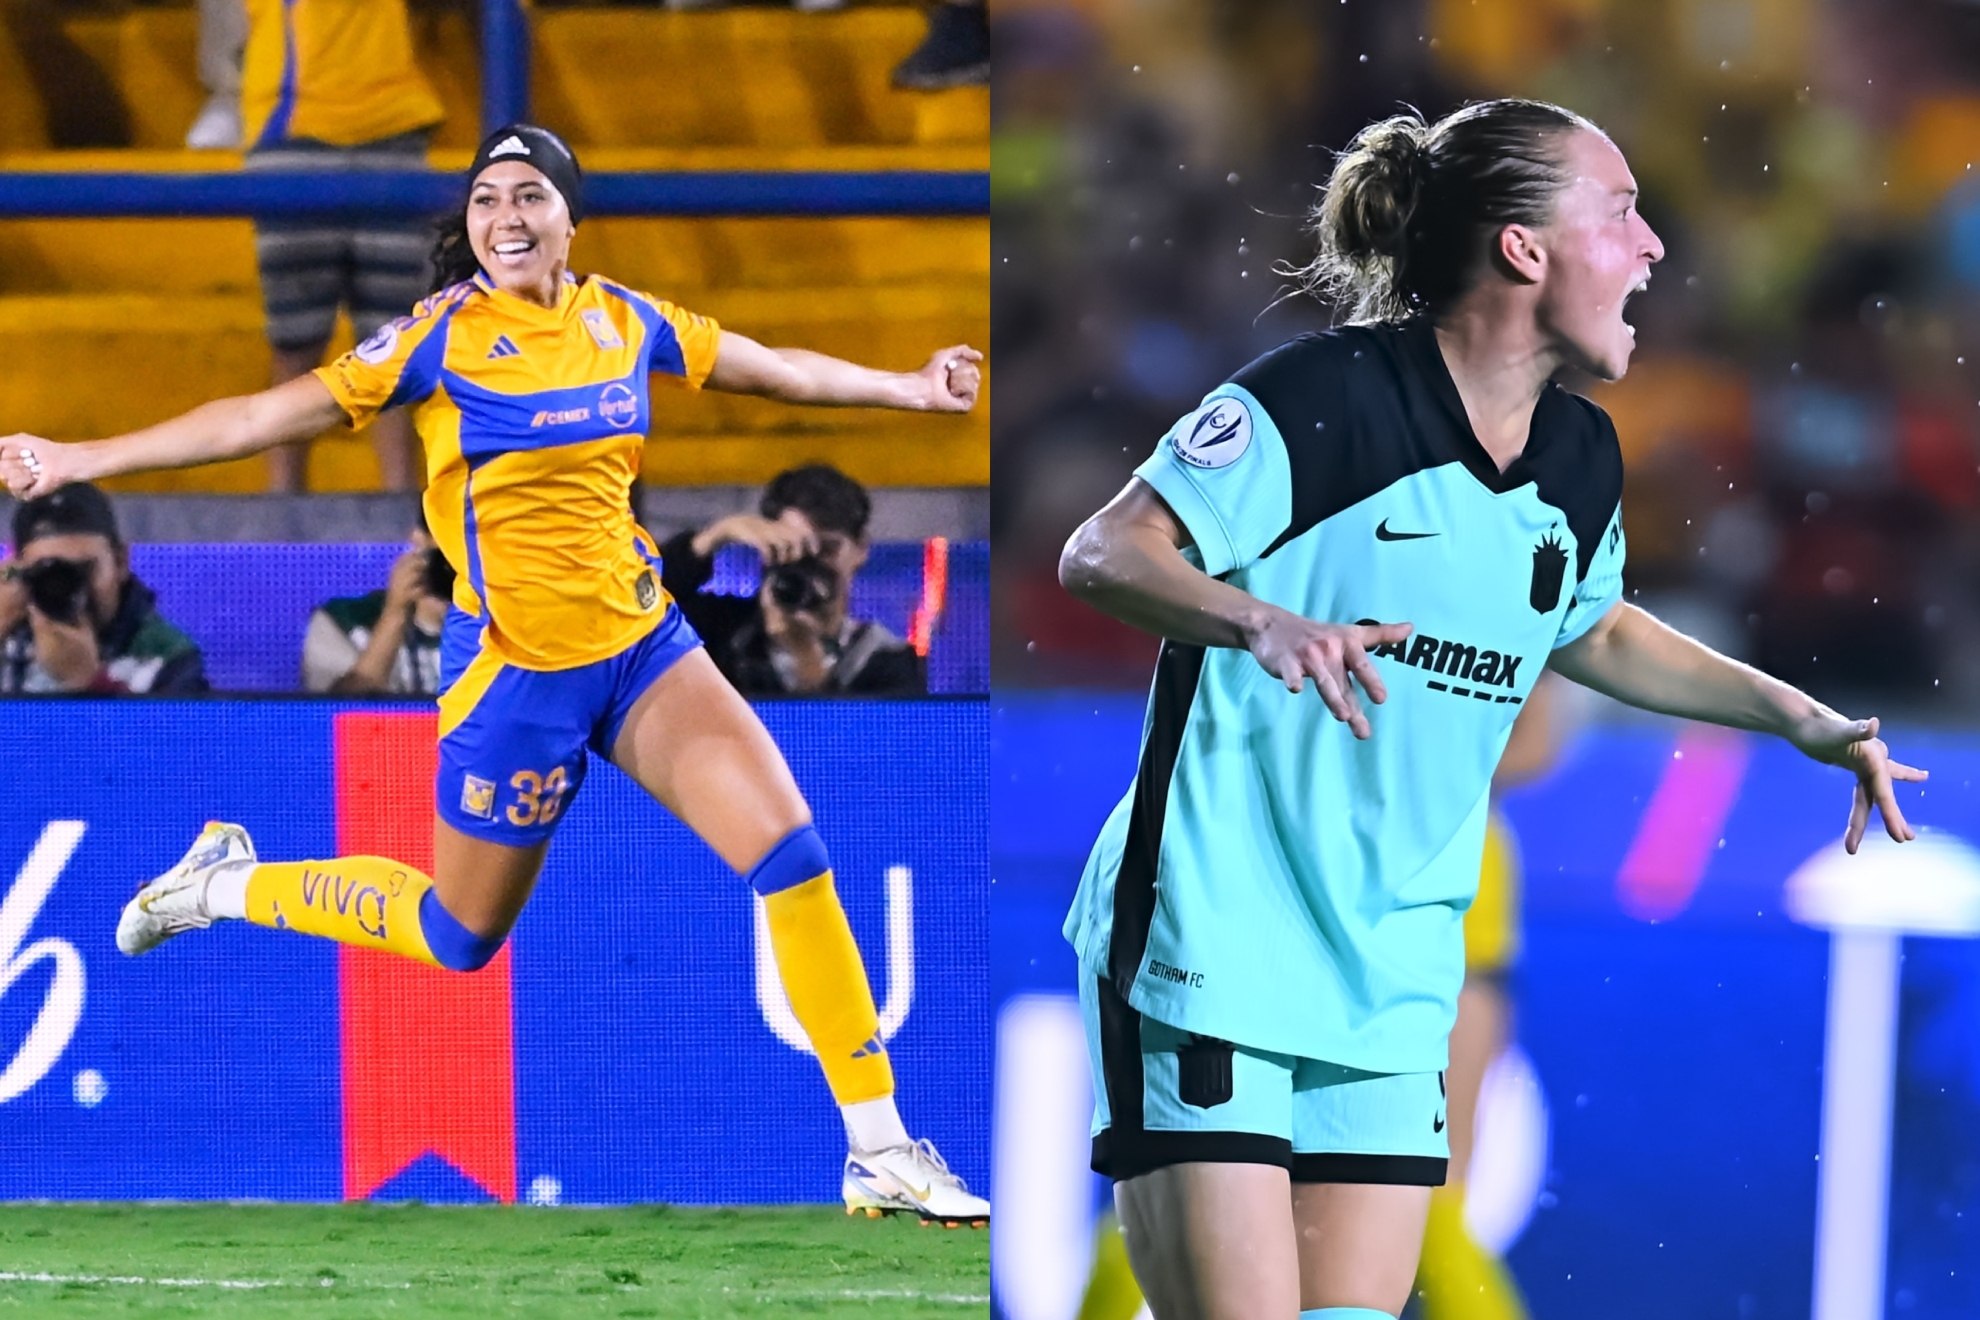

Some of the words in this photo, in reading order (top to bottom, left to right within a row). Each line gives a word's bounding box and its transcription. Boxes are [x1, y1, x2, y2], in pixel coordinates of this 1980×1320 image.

[547, 408, 590, 425] CEMEX
[1148, 959, 1188, 986] GOTHAM
[1189, 972, 1204, 988] FC
